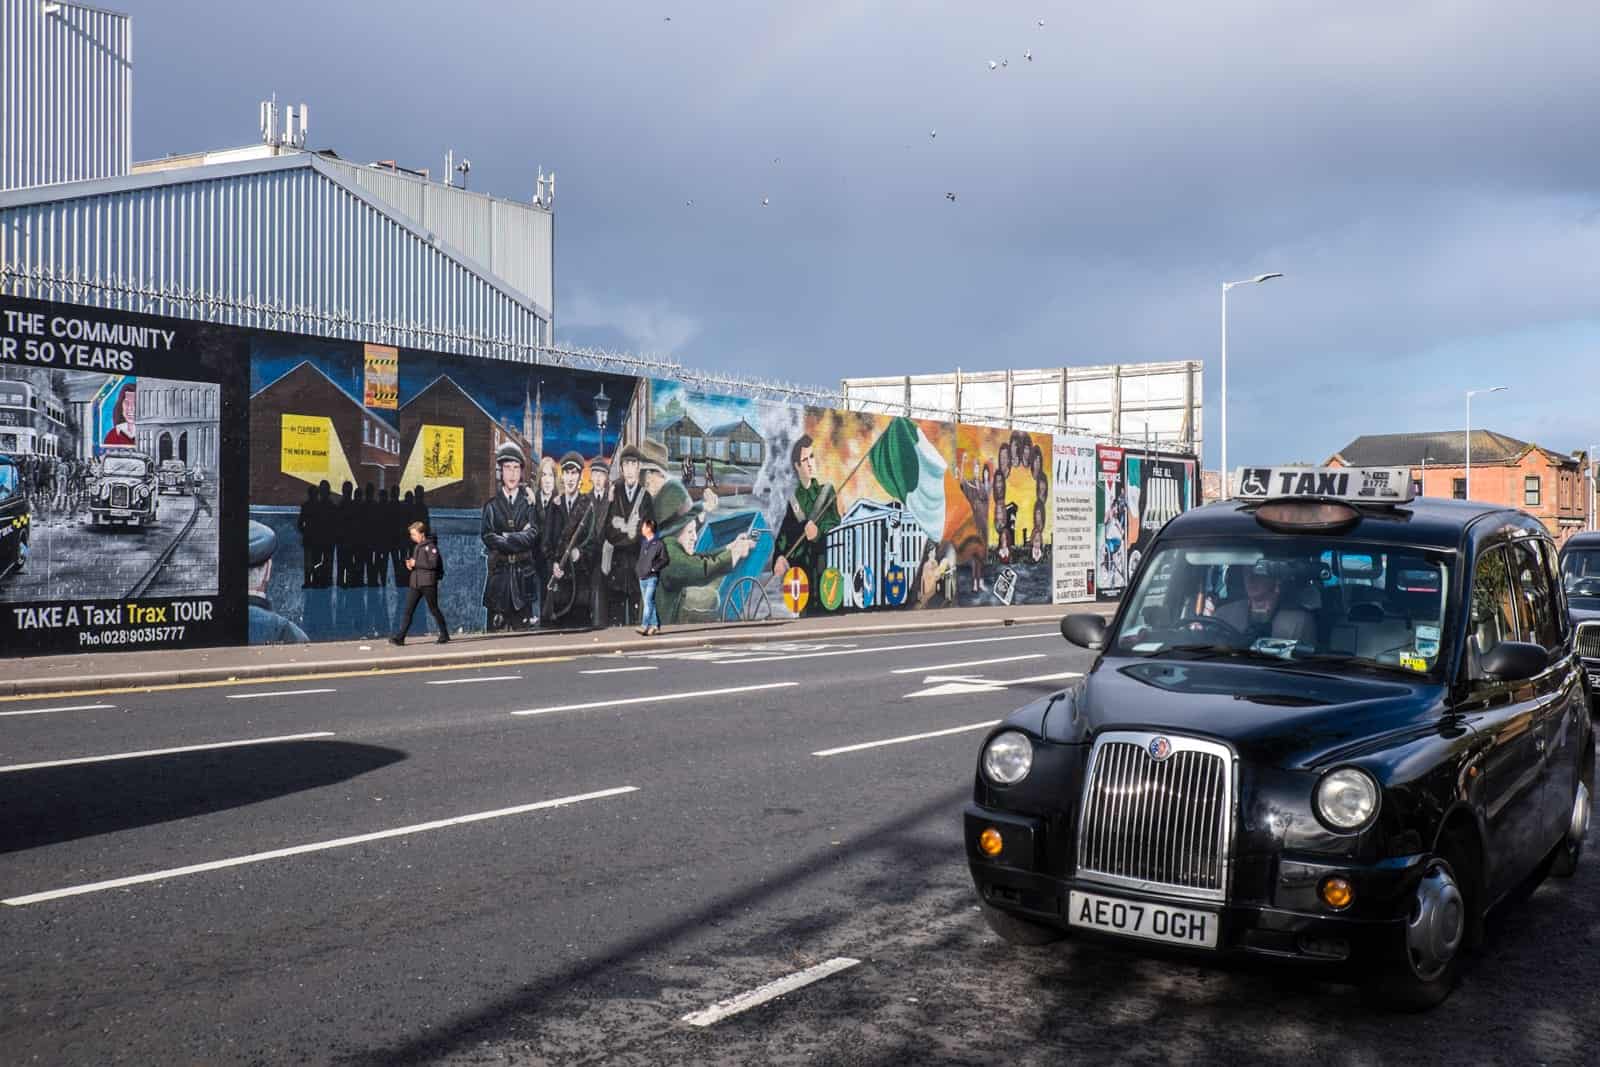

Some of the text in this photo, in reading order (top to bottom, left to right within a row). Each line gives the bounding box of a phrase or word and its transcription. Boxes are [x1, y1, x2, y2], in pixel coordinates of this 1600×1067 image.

[4, 310, 176, 351] THE COMMUNITY
[25, 340, 56, 362] 50
[60, 343, 134, 371] YEARS
[1279, 472, 1349, 496] TAXI
[13, 601, 213, 630] TAKE A Taxi Trax TOUR
[1080, 898, 1206, 941] AE07 OGH
